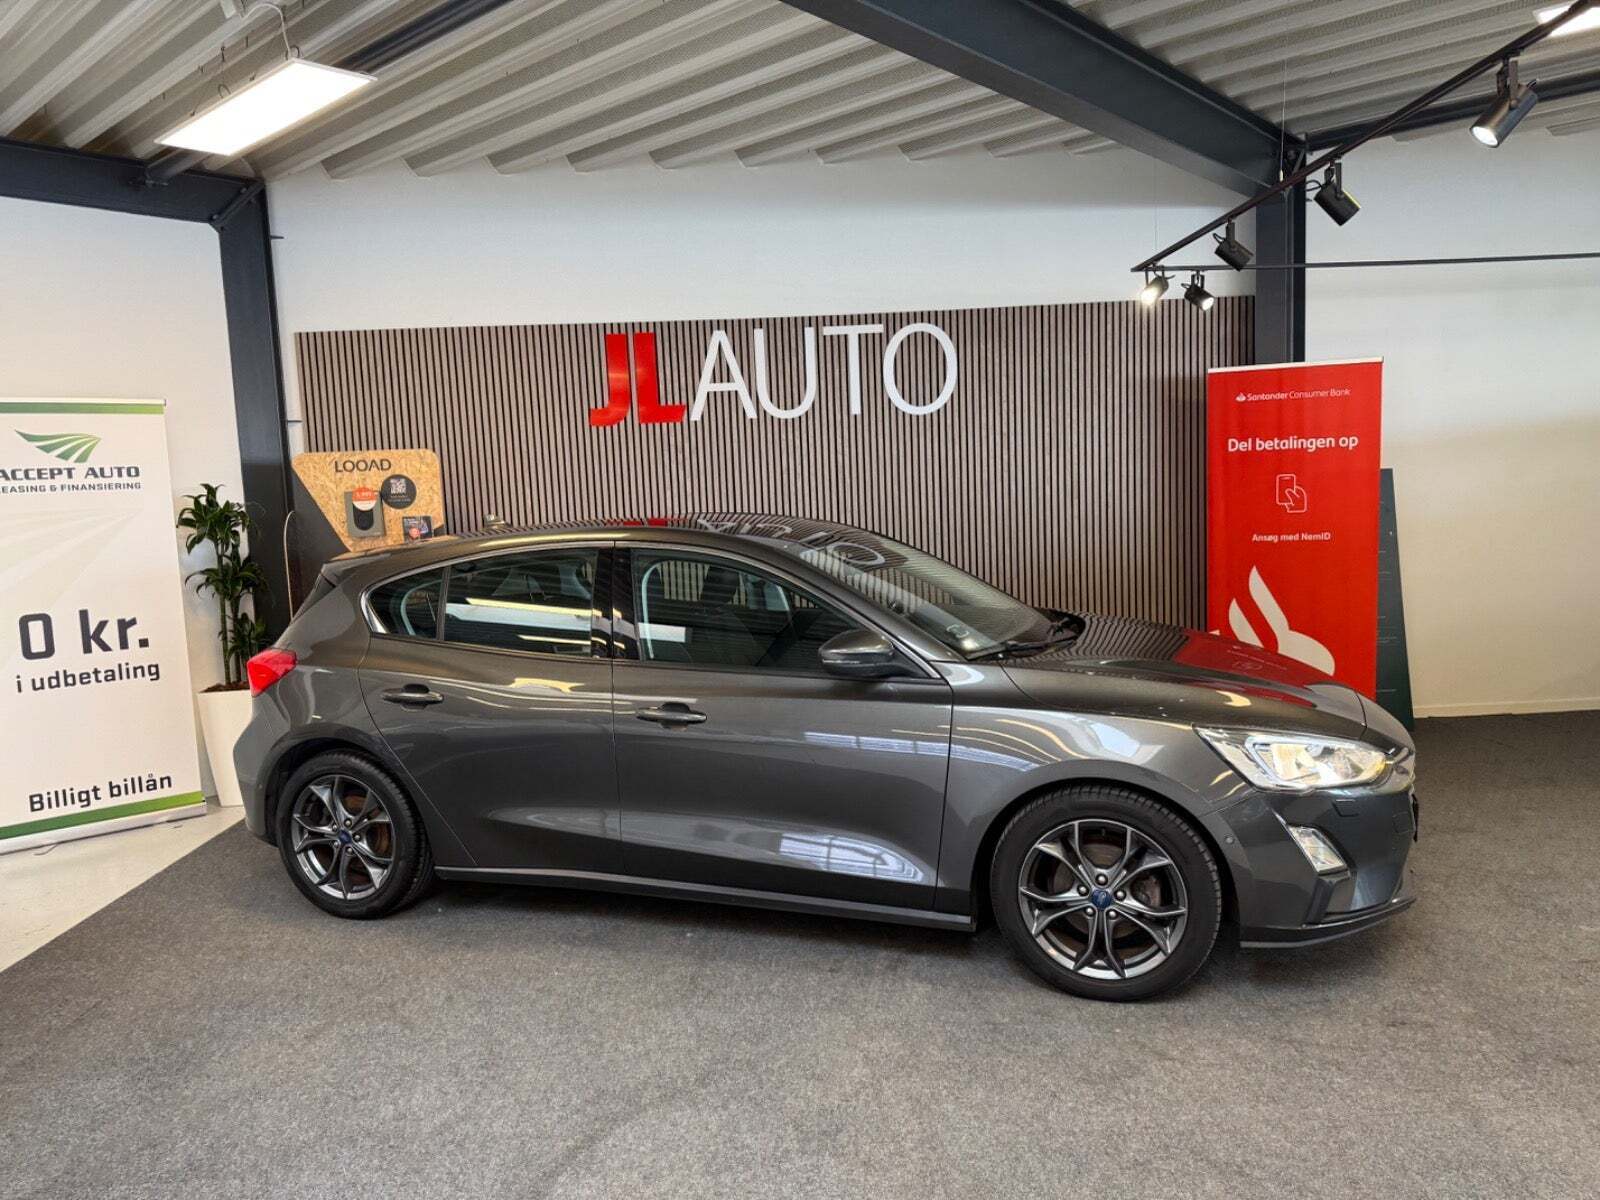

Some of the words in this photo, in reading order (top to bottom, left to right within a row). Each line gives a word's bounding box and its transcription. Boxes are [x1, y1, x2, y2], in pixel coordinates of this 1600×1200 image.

[588, 332, 687, 427] JL
[690, 322, 958, 421] AUTO
[1247, 393, 1288, 401] Santander
[1330, 388, 1351, 397] Bank
[1228, 438, 1252, 452] Del
[1256, 436, 1335, 452] betalingen
[1339, 436, 1359, 450] op
[335, 459, 391, 472] LOOAD
[0, 467, 76, 481] ACCEPT
[84, 466, 140, 479] AUTO
[0, 485, 46, 494] EASING
[61, 482, 141, 492] FINANSIERING
[1280, 533, 1299, 541] med
[1302, 532, 1331, 541] NemID
[19, 613, 55, 660] 0
[79, 609, 149, 654] kr.
[16, 675, 22, 693] i
[32, 662, 160, 691] udbetaling
[29, 785, 101, 812] Billigt
[109, 773, 172, 798] billån
